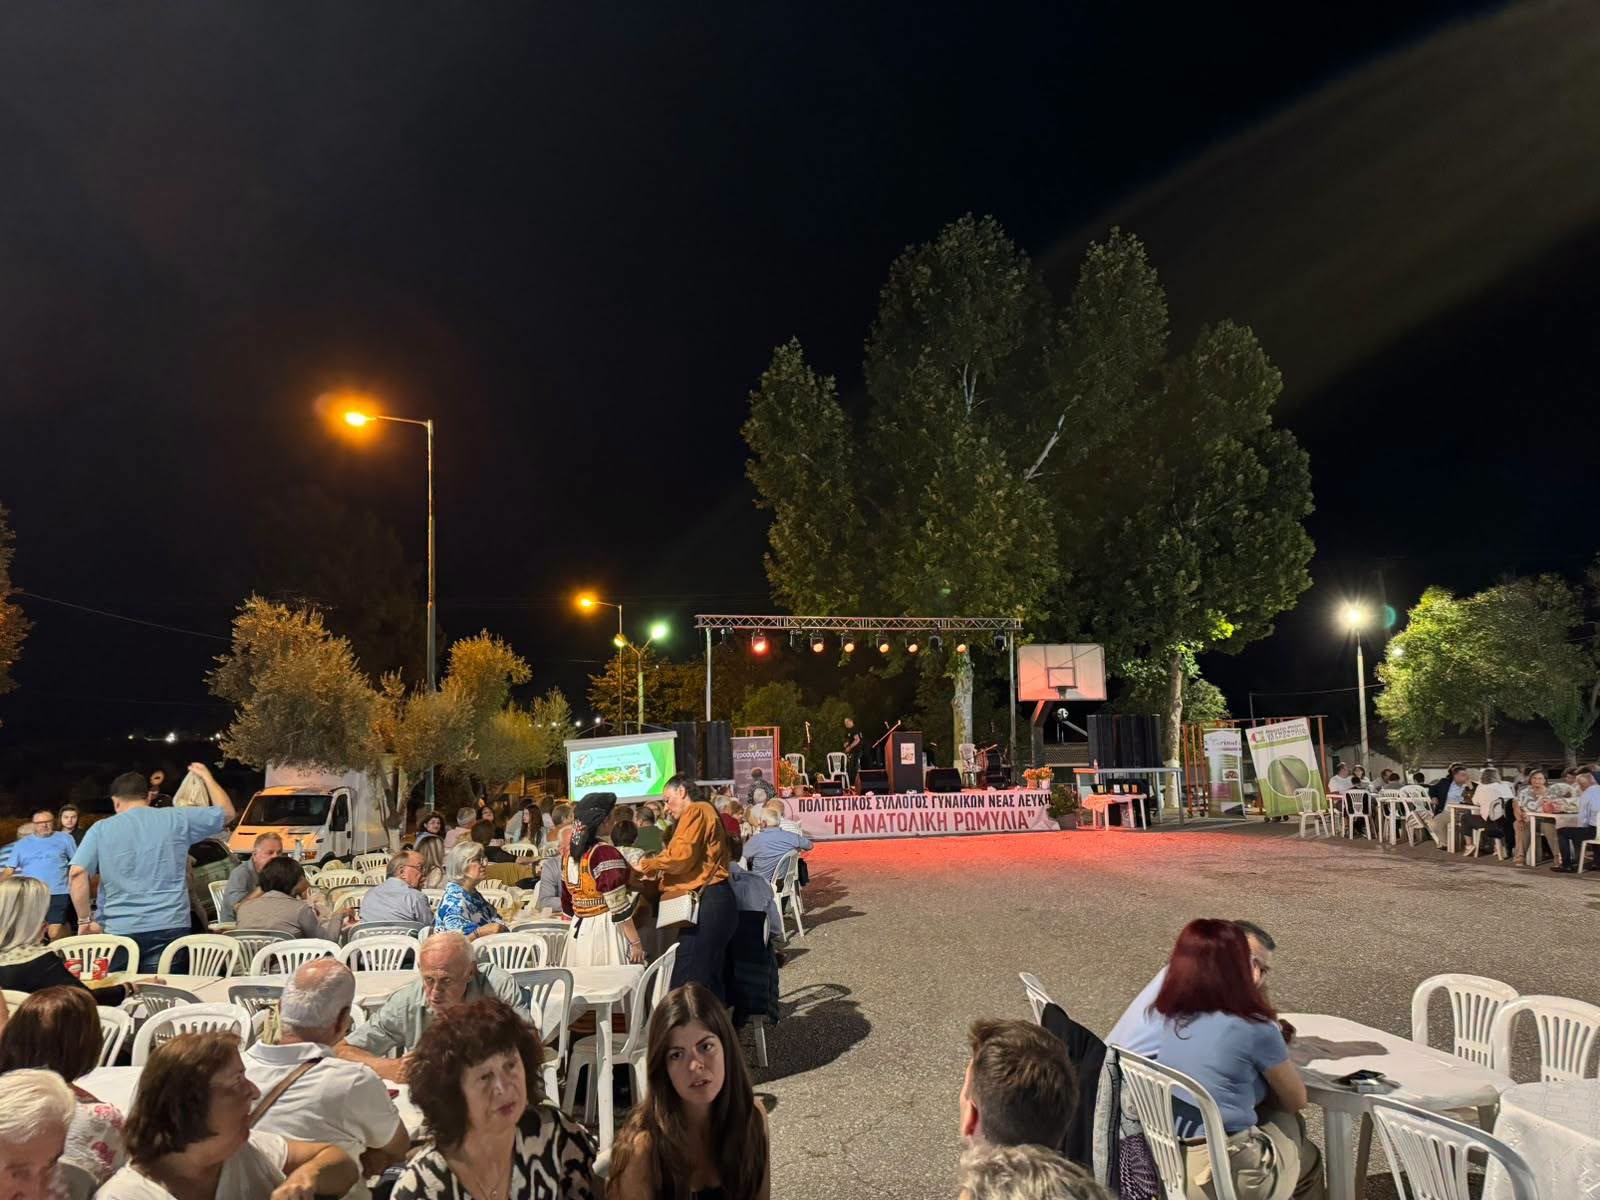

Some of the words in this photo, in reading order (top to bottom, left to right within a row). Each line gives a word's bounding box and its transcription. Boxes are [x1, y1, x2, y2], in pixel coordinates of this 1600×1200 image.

[799, 796, 872, 812] ΠΟΛΙΤΙΣΤΙΚΟΣ
[875, 795, 928, 810] ΣΥΛΛΟΓΟΣ
[931, 794, 985, 809] ΓΥΝΑΙΚΩΝ
[988, 794, 1015, 807] ΝΕΑΣ
[1018, 793, 1051, 806] ΛΕΥΚΗ
[851, 812, 947, 833] ΑΝΑΤΟΛΙΚΗ
[954, 811, 1035, 832] ΡΩΜΥΛΙΑ”
